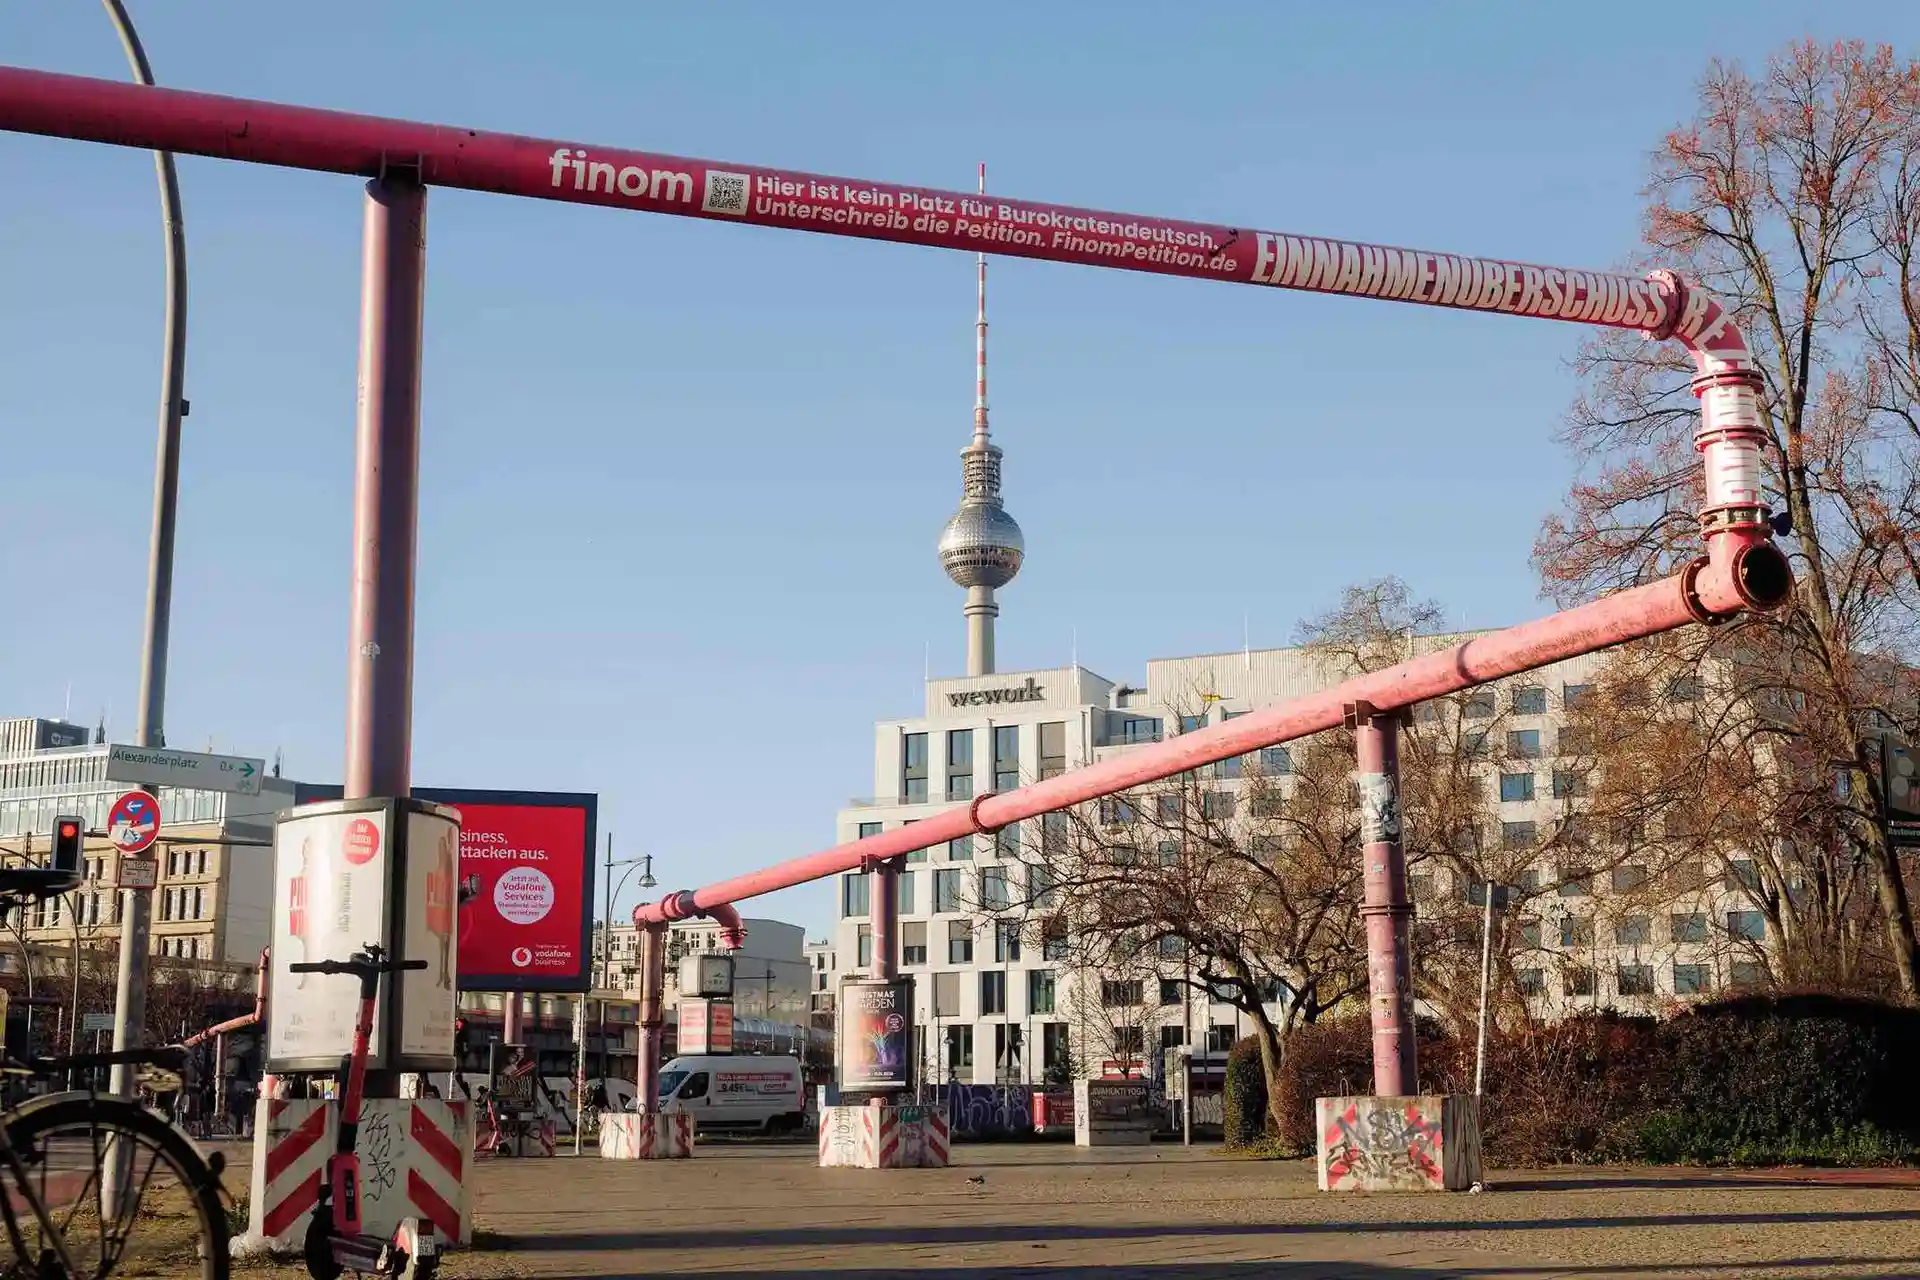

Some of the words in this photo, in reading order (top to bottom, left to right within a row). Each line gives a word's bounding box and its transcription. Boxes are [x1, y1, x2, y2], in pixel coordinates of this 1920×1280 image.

[549, 148, 693, 203] finom
[756, 175, 805, 197] Hier
[810, 180, 839, 201] ist
[844, 184, 893, 207] kein
[899, 192, 956, 215] Platz
[960, 197, 993, 219] für
[755, 196, 909, 231] Unterschreib
[913, 212, 949, 234] die
[954, 217, 1046, 248] Petition.
[1052, 230, 1238, 273] FinomPetition.de
[945, 677, 1047, 708] wework
[111, 750, 199, 771] Alexanderplatz
[460, 829, 508, 845] siness,
[519, 849, 549, 861] aus.
[502, 882, 546, 892] Vodafone
[504, 891, 544, 902] Services
[535, 949, 571, 958] vodafone
